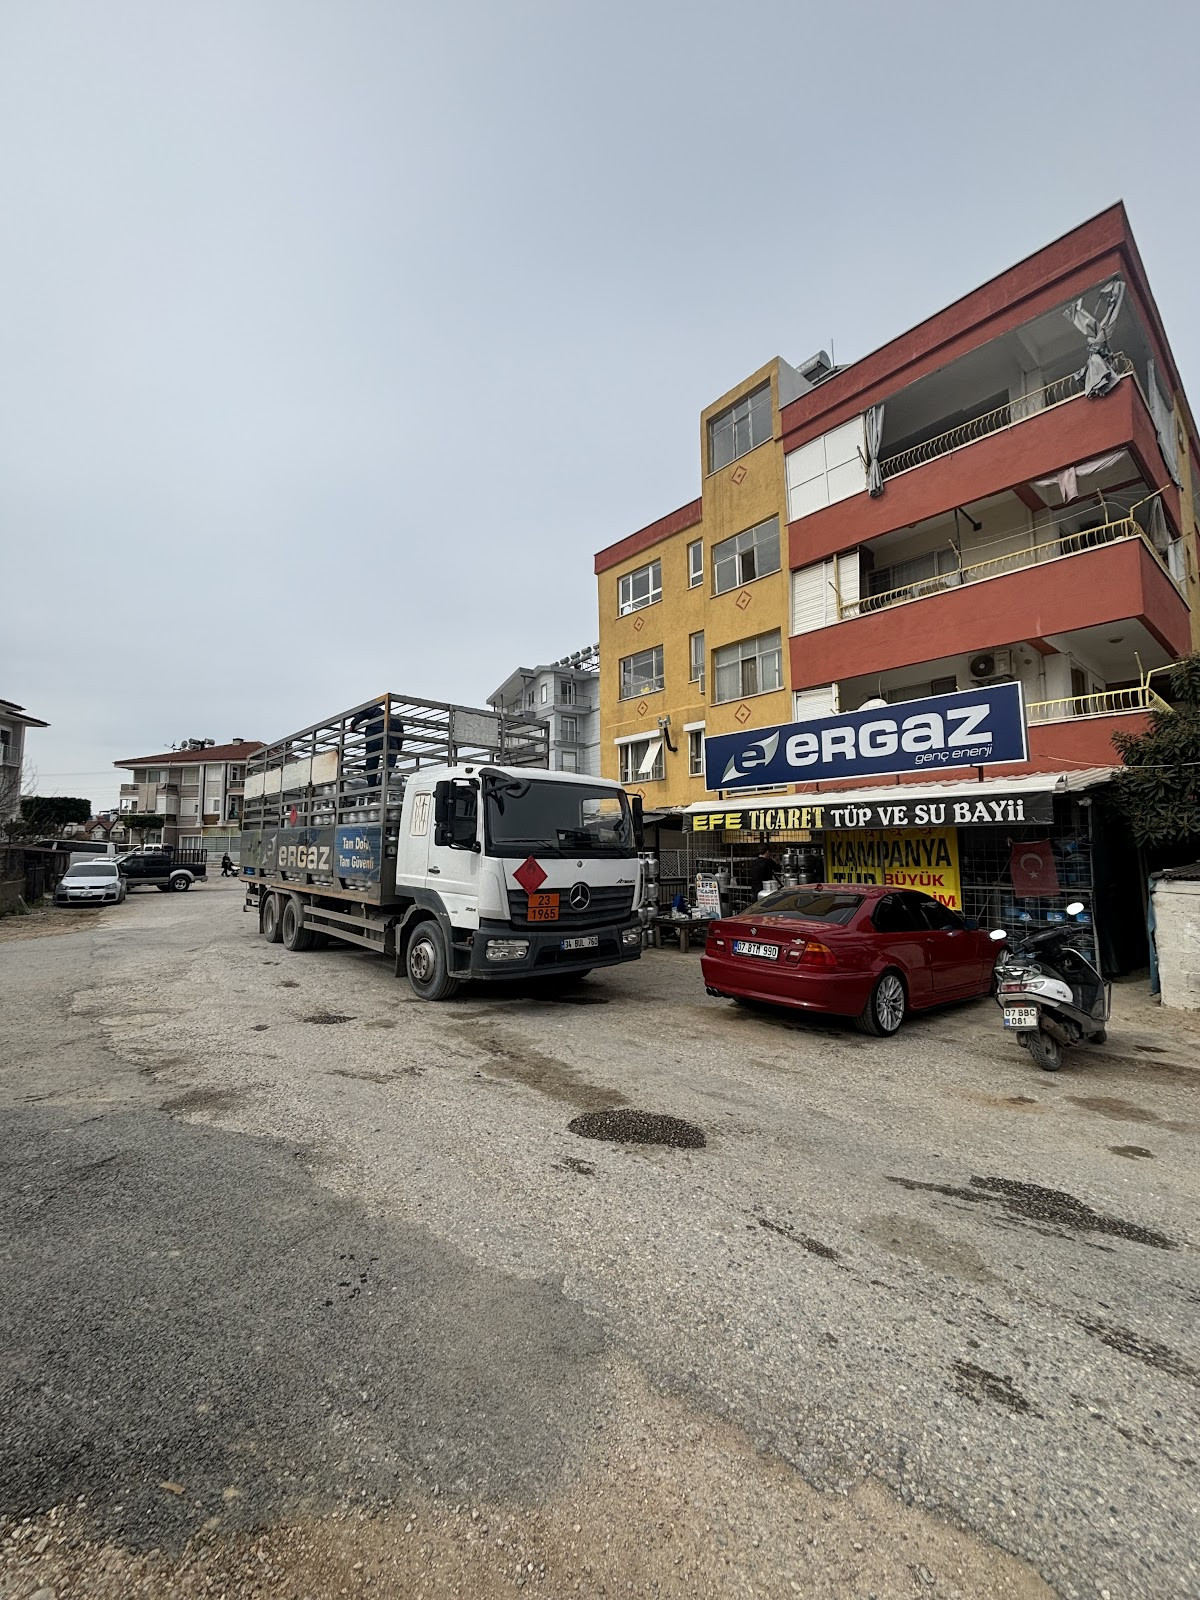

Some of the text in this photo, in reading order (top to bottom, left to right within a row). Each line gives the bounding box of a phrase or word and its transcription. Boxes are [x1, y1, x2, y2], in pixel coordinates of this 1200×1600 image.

[915, 743, 993, 765] genç enerji
[693, 812, 743, 831] EFE
[830, 804, 872, 828] TÜP
[877, 805, 909, 826] VE
[914, 803, 946, 825] SU
[342, 836, 354, 849] Tam
[830, 838, 952, 867] KAMPANYA
[339, 855, 350, 867] Tam
[884, 871, 945, 887] BÜYÜK
[538, 895, 551, 906] 23
[531, 909, 556, 920] 1965
[763, 945, 777, 956] 990
[1018, 1008, 1036, 1017] BBC
